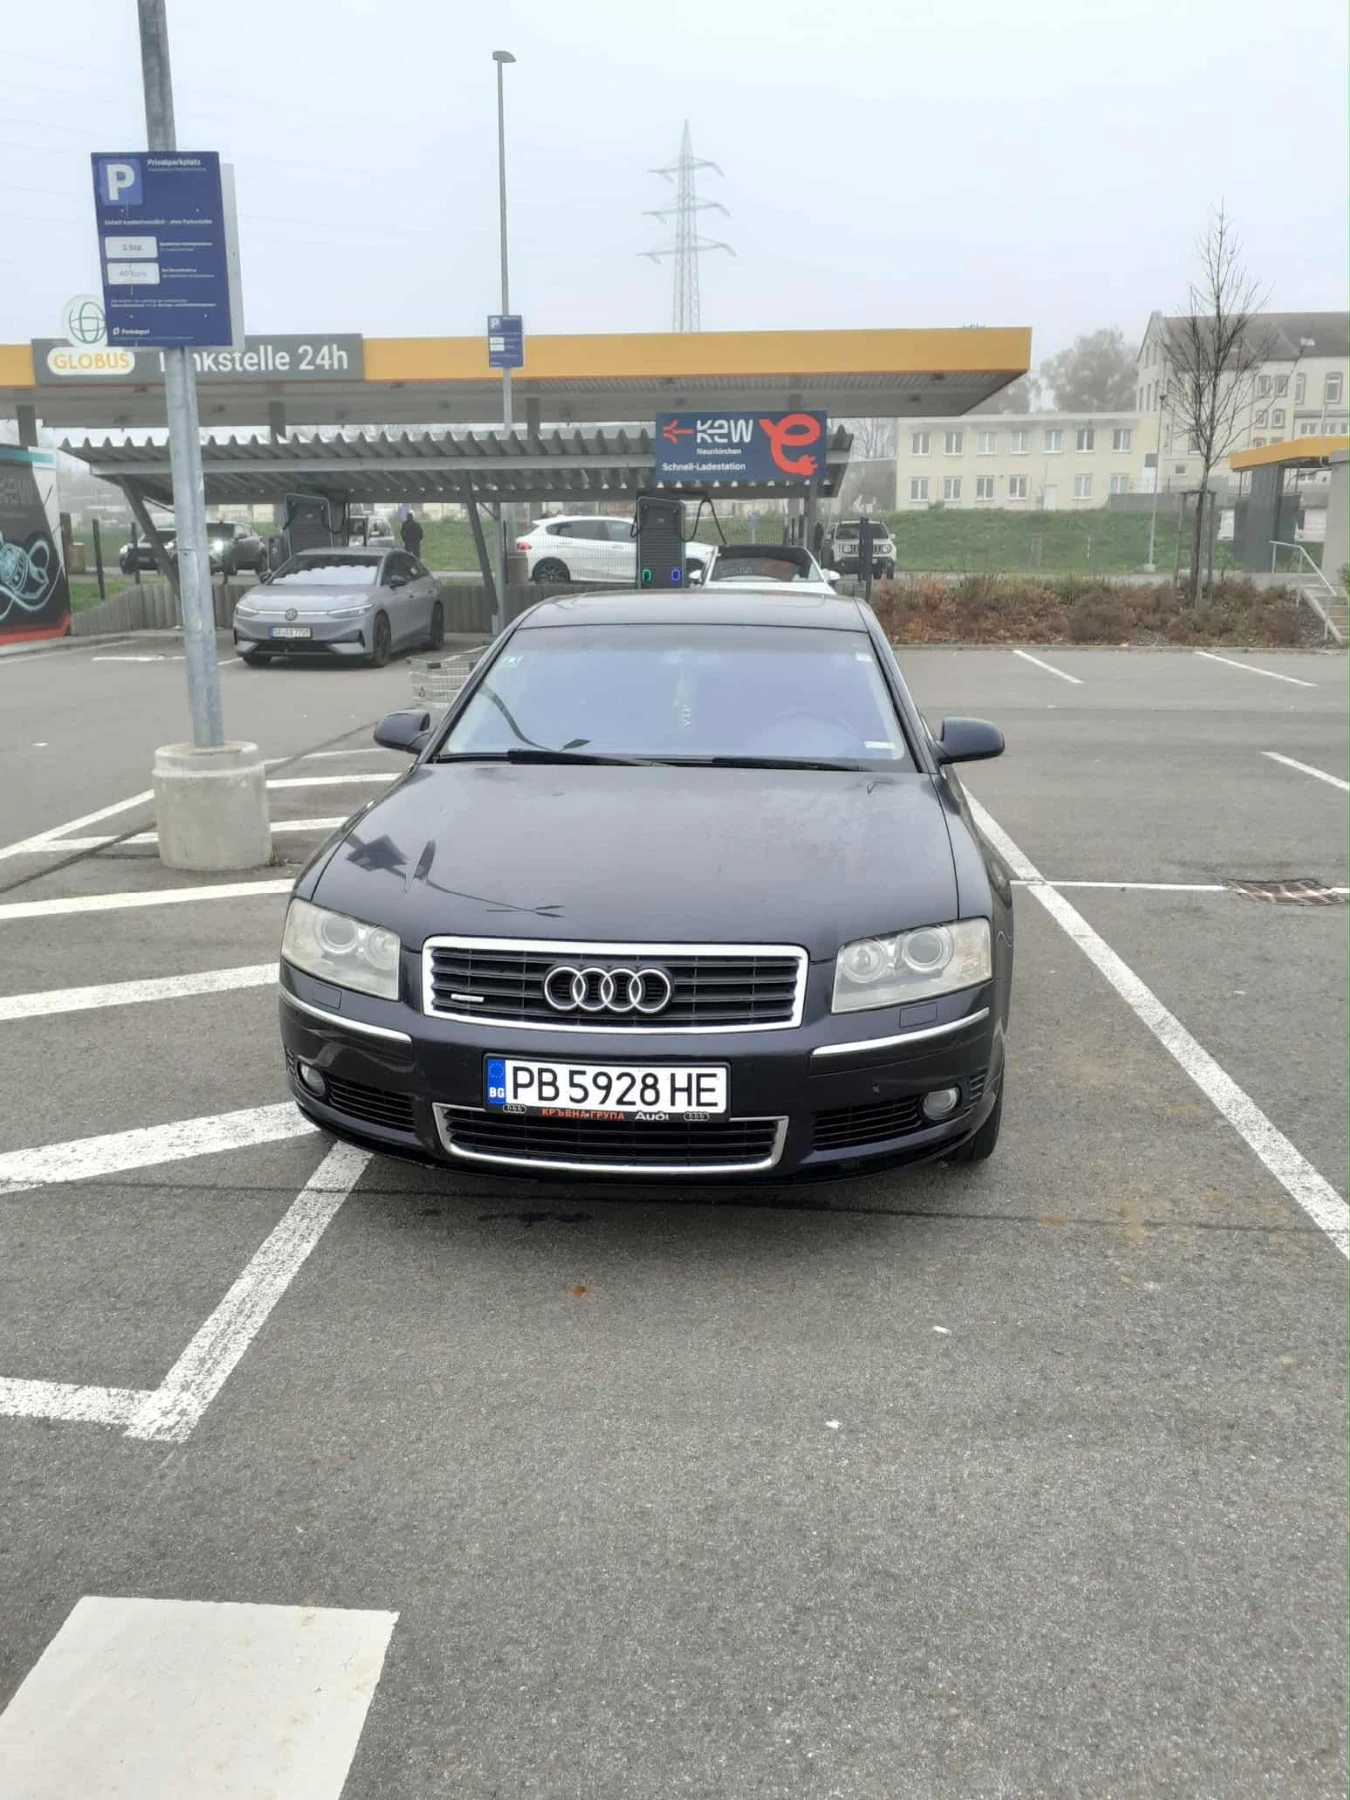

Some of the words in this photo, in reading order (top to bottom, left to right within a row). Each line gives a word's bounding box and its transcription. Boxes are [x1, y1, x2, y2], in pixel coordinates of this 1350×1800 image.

[106, 163, 135, 201] P
[53, 349, 131, 370] GLOBUS
[159, 345, 290, 373] nkstelle
[297, 345, 349, 371] 24h
[662, 462, 746, 471] Schnell-Ladestation
[489, 1087, 505, 1098] BG
[634, 1110, 670, 1122] Audi
